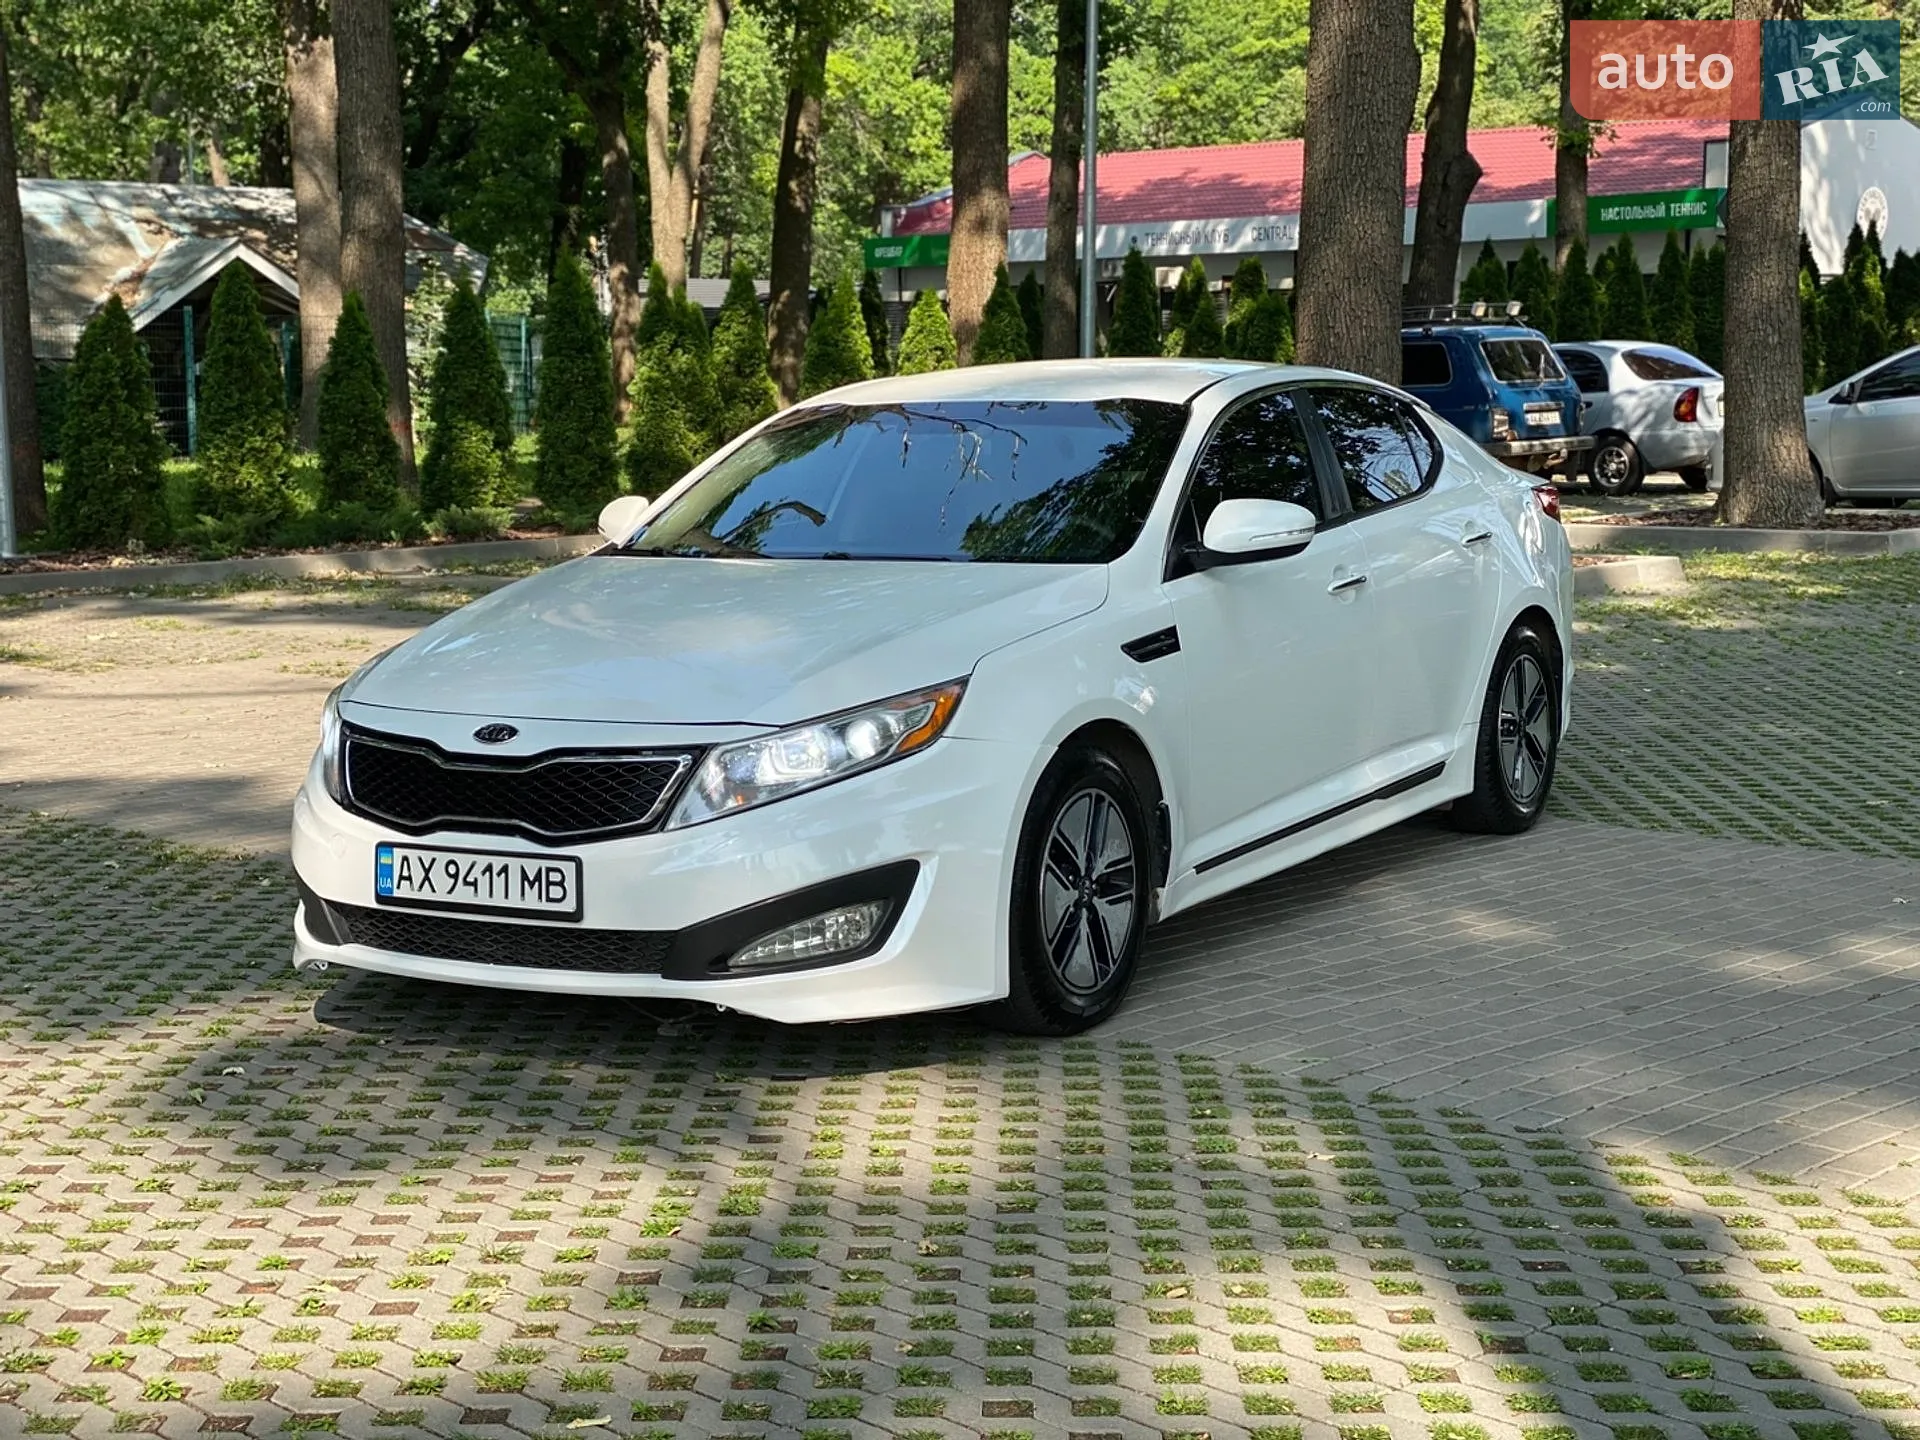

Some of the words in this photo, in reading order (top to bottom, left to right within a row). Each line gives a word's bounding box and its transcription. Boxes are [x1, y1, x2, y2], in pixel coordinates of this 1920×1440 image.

[1600, 201, 1666, 221] НАСТОЛЬНЫЙ
[1670, 201, 1708, 217] ТЕННИС
[1251, 224, 1295, 242] CENTRAL
[379, 877, 392, 889] UA
[396, 855, 437, 894] AX
[444, 858, 510, 900] 9411
[520, 864, 568, 904] MB
